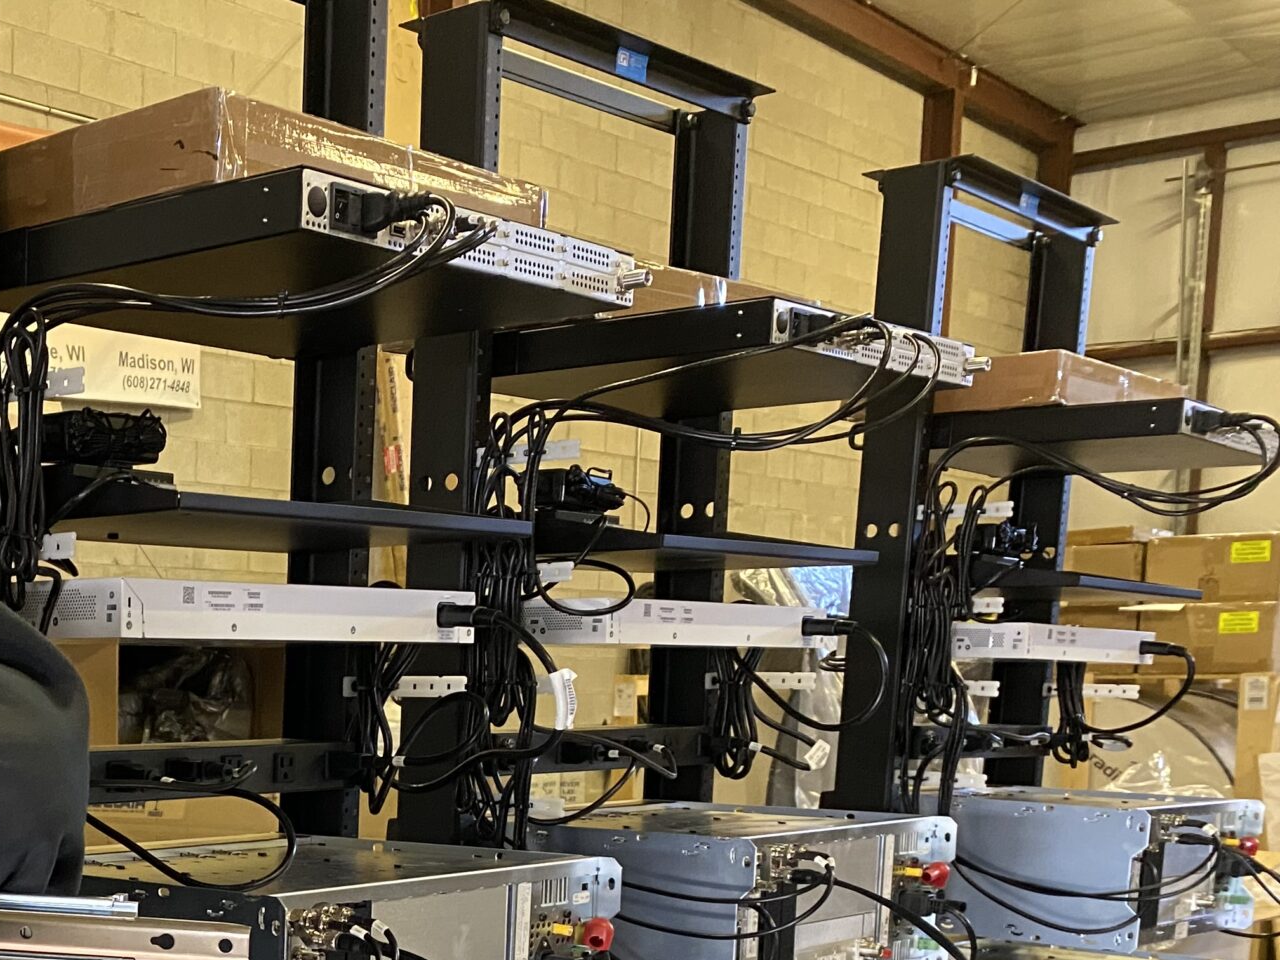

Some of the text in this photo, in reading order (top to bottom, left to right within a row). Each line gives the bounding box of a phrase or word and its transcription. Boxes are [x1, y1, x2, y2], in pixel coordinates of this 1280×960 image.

[66, 345, 86, 362] WI
[118, 351, 195, 375] Madison, WI
[122, 376, 191, 394] (608)271-4848
[1089, 753, 1123, 781] radi
